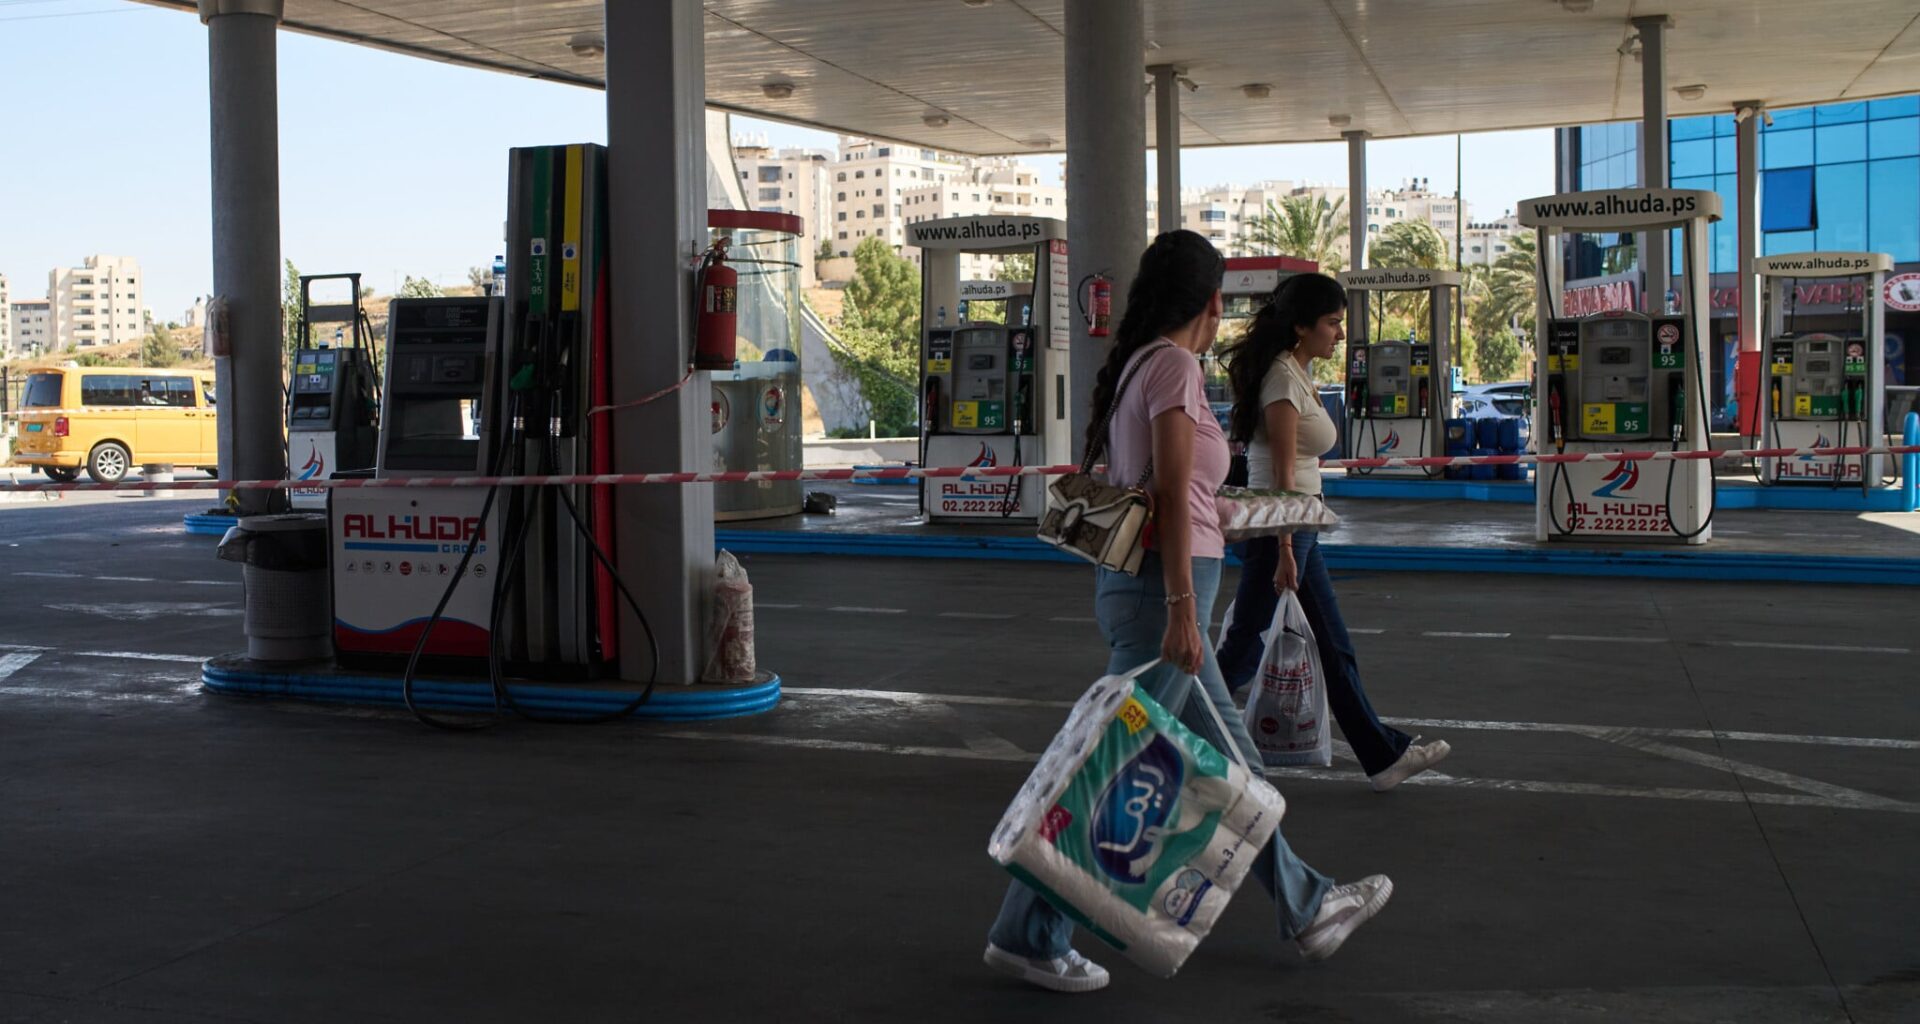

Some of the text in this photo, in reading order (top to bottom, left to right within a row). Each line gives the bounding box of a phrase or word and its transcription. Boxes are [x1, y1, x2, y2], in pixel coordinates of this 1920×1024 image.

[1534, 193, 1695, 217] www.alhuda.ps
[915, 220, 1040, 240] www.alhuda.ps
[1768, 257, 1869, 270] www.alhuda.ps
[1347, 272, 1431, 285] www.alhuda.ps
[531, 286, 542, 295] 95
[961, 284, 1006, 295] .alhuda.ps
[1563, 281, 1635, 317] HAWARMA
[1661, 355, 1676, 366] 95
[984, 416, 997, 426] 95
[1624, 420, 1639, 431] 95
[943, 500, 986, 512] 02.222
[1123, 704, 1142, 724] 32
[1097, 762, 1166, 854] ريما
[1222, 848, 1235, 860] 3
